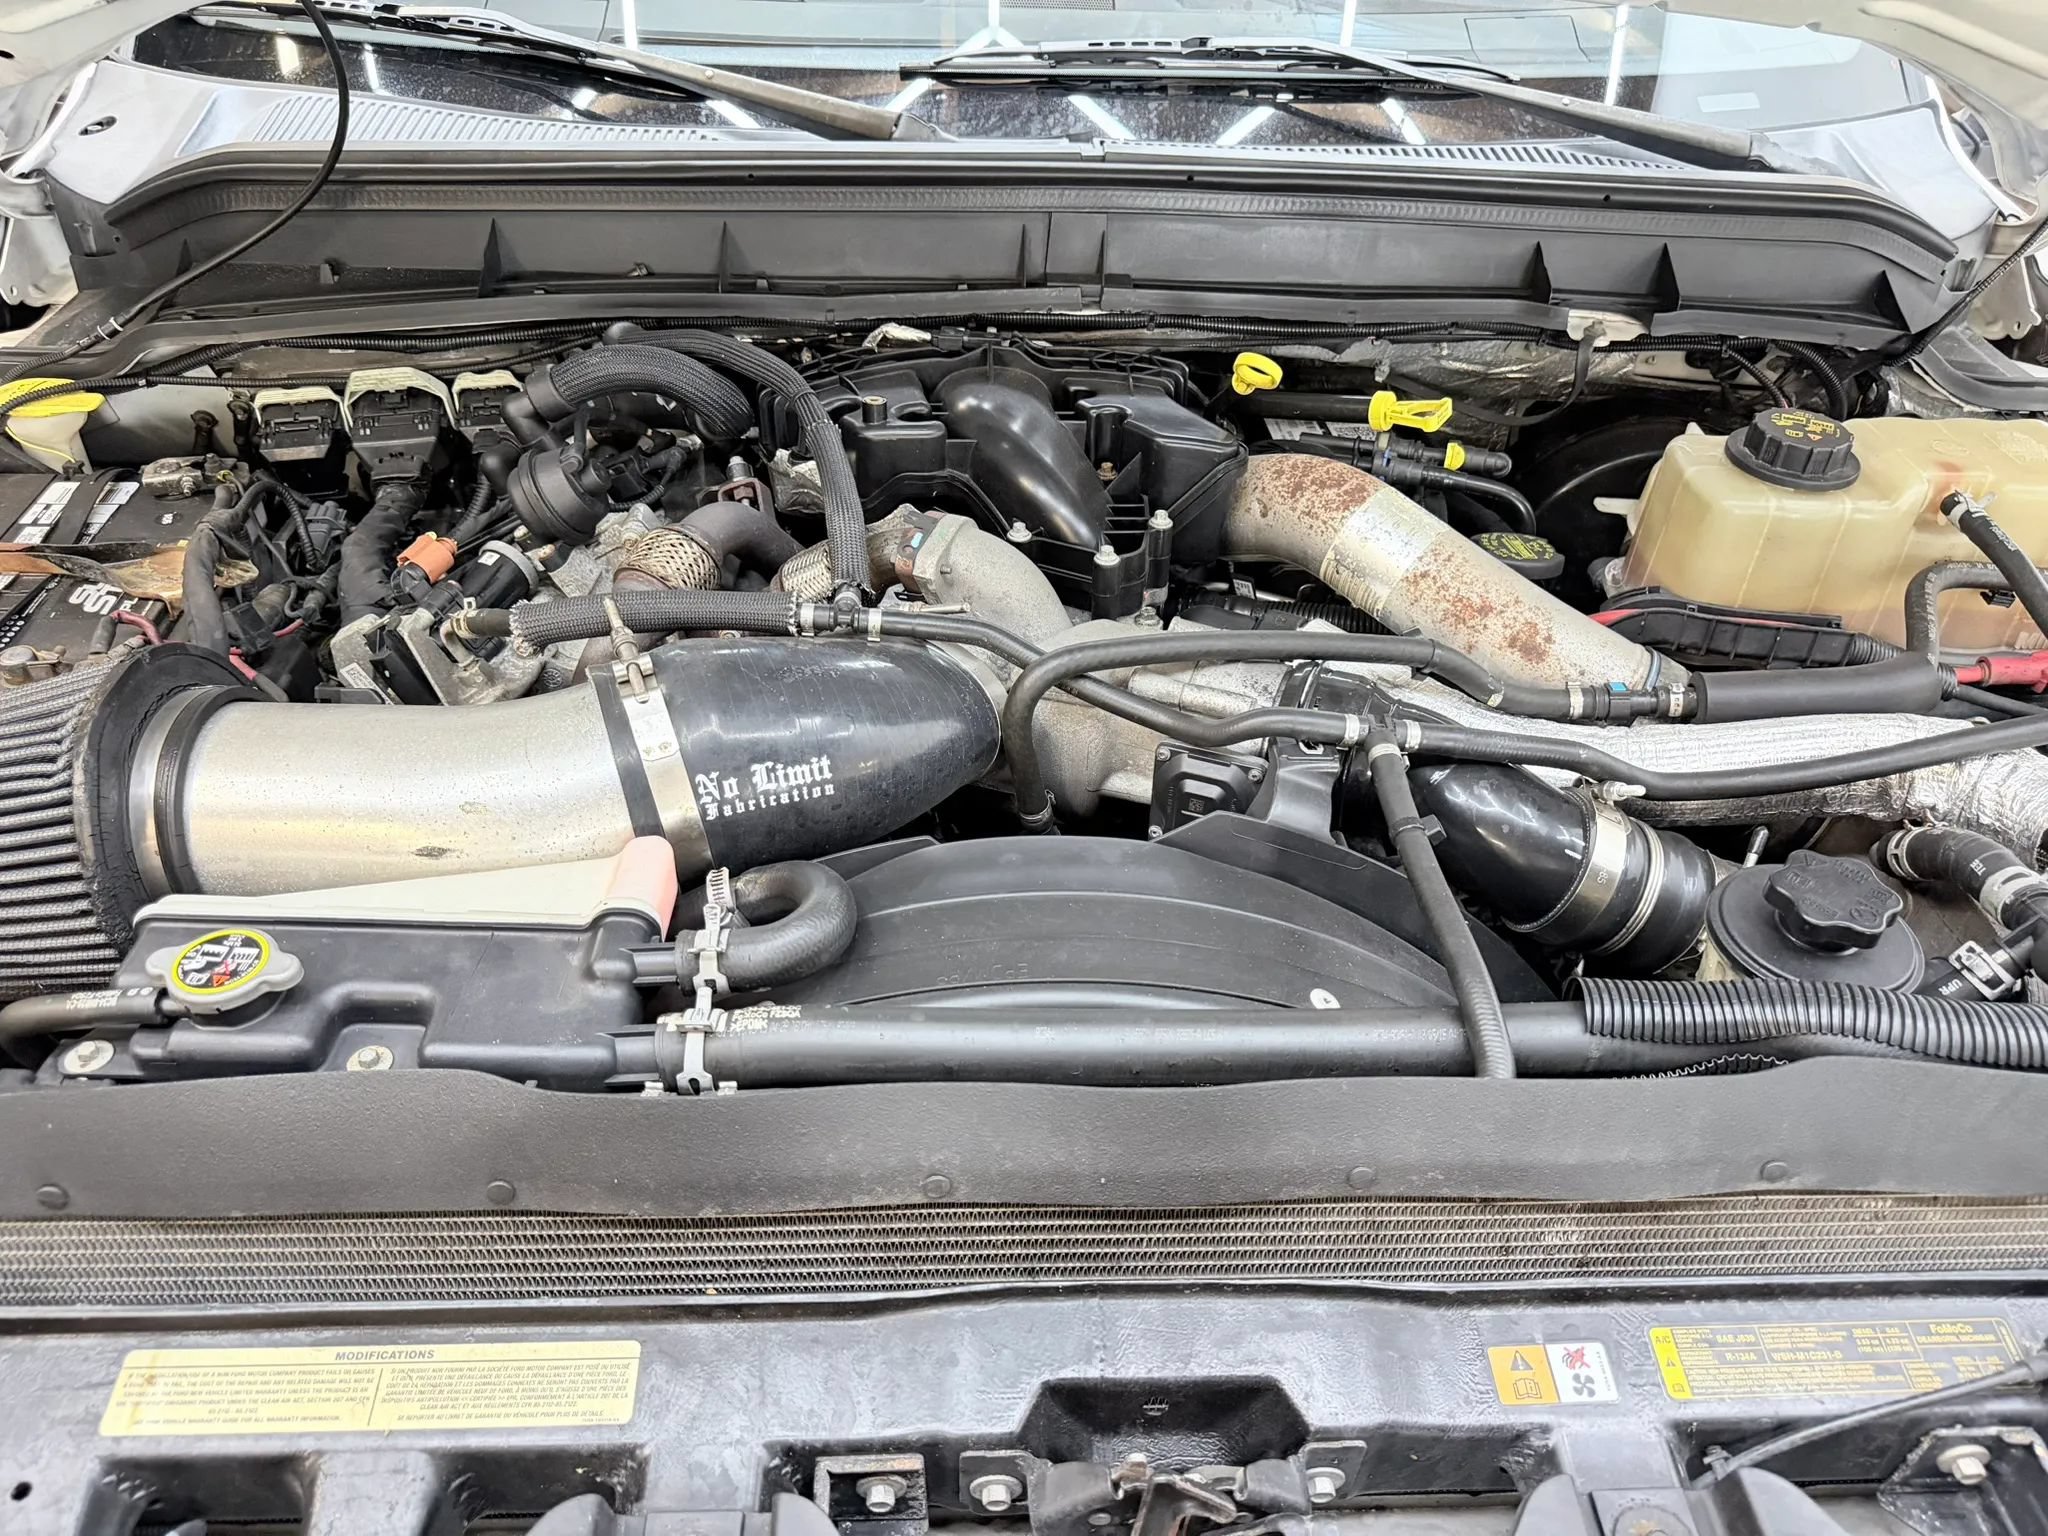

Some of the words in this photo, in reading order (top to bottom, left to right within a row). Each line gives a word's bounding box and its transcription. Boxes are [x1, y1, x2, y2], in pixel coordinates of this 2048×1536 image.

[695, 771, 740, 804] No
[751, 754, 833, 792] Limit
[705, 783, 835, 821] Fabrication
[1938, 978, 1963, 995] UPR
[335, 1350, 434, 1361] MODIFICATIONS
